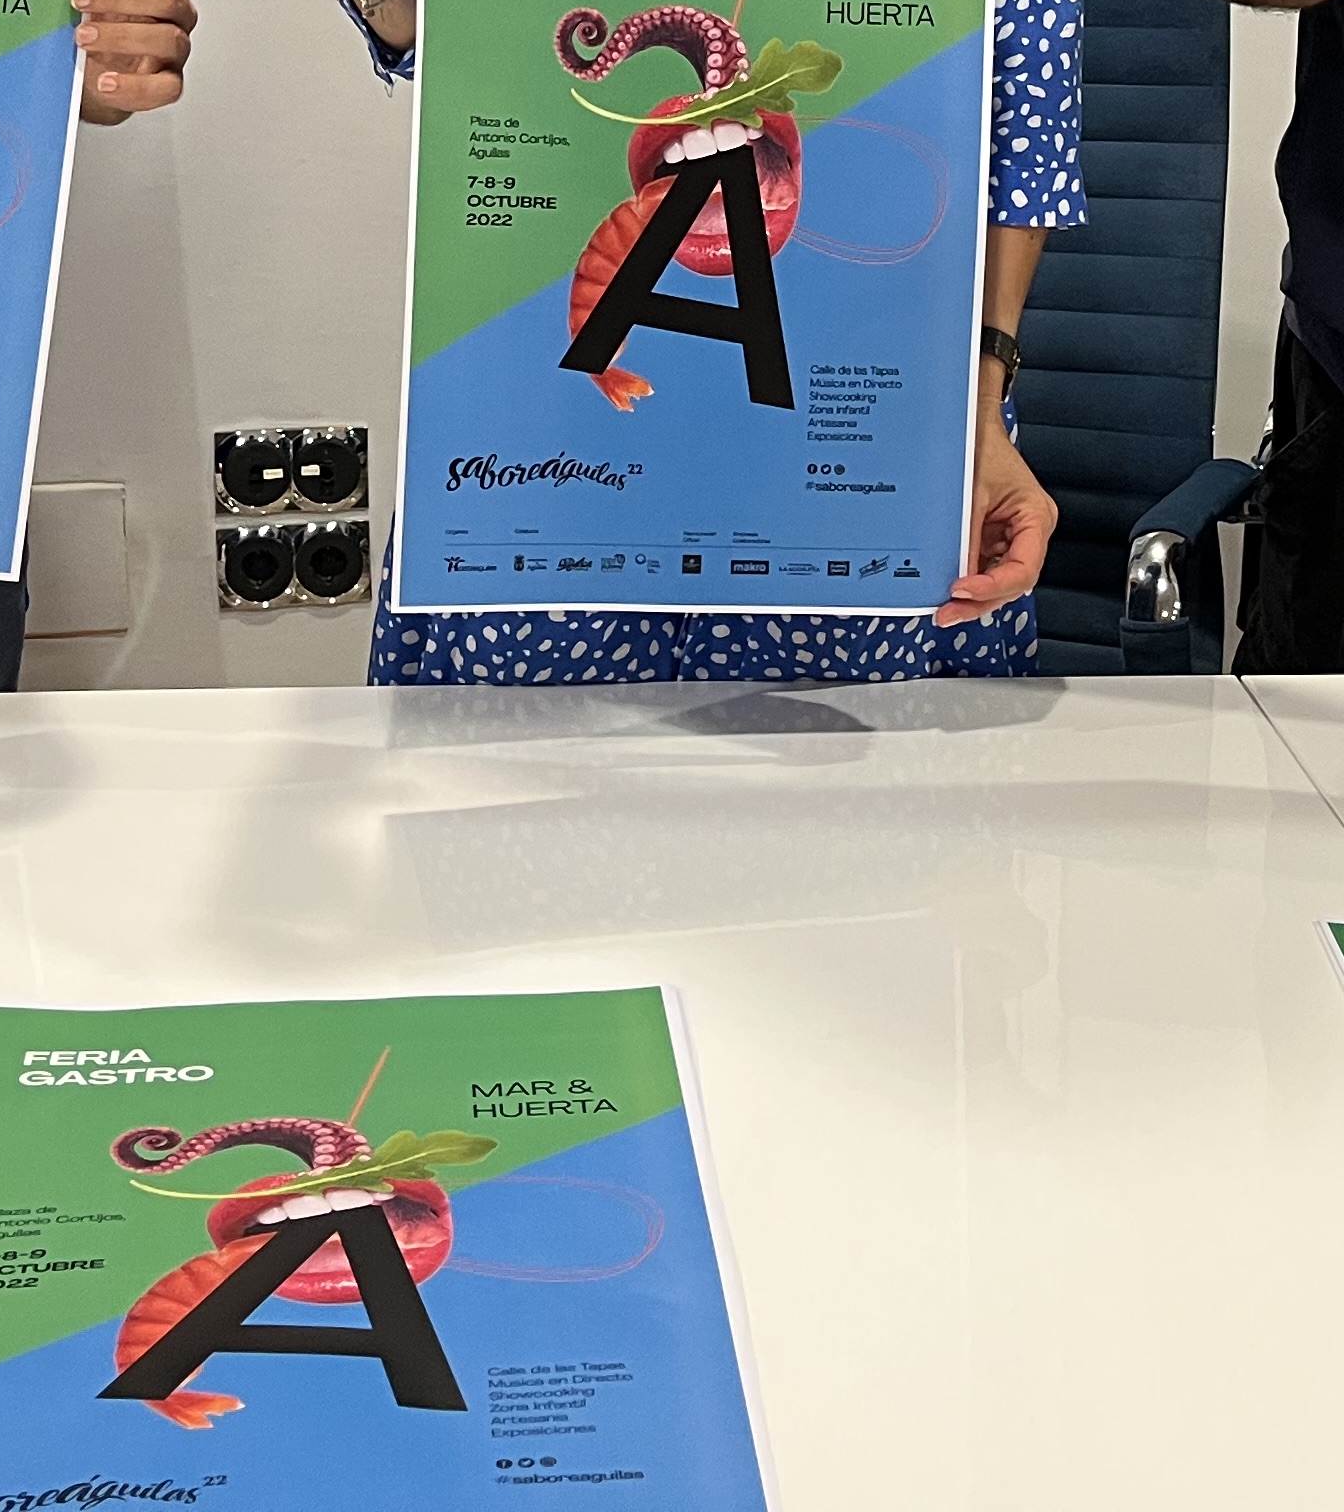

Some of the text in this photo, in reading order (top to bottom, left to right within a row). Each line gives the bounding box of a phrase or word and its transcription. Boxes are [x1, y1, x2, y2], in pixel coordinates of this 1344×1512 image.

[825, 1, 935, 28] HUERTA
[470, 115, 520, 129] Plaza de
[469, 131, 517, 144] Antonio
[467, 175, 516, 189] 7-8-9
[467, 194, 558, 210] OCTUBRE
[465, 213, 513, 226] 2022
[838, 365, 851, 376] de
[22, 1047, 152, 1067] FERIA
[17, 1064, 215, 1087] GASTRO
[471, 1078, 595, 1099] MAR &
[472, 1096, 619, 1120] HUERTA
[36, 1206, 57, 1214] de
